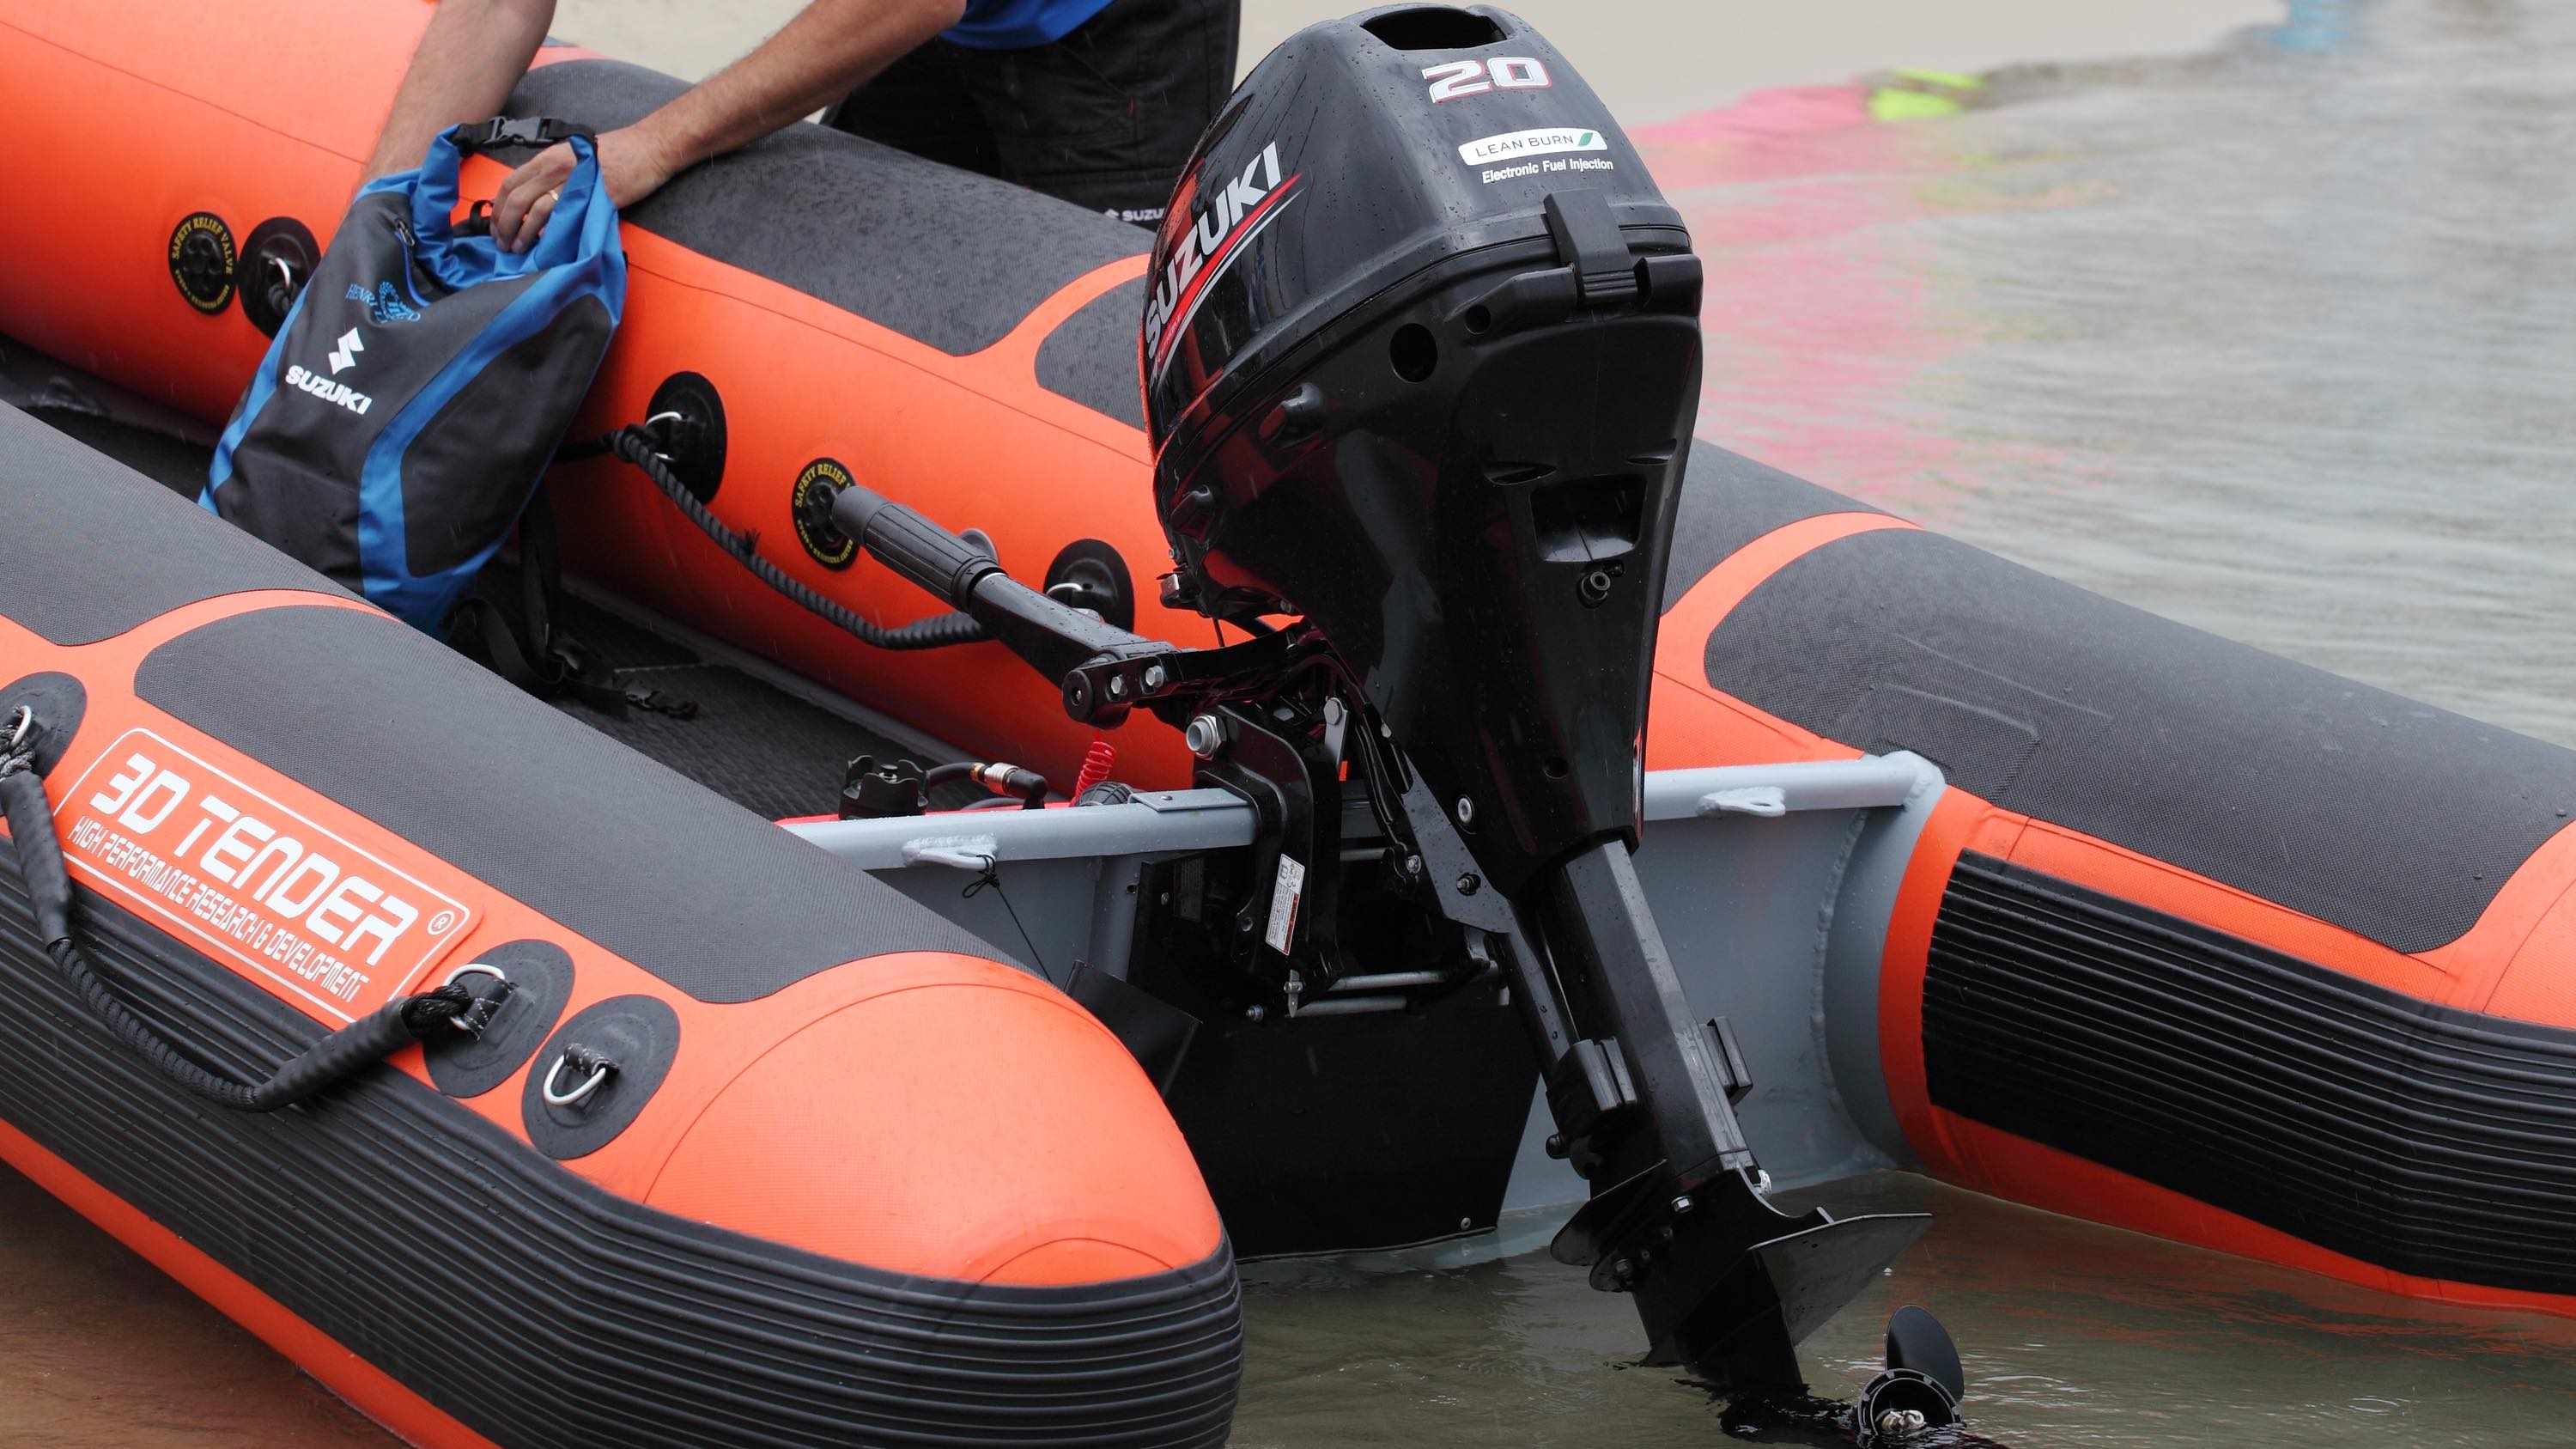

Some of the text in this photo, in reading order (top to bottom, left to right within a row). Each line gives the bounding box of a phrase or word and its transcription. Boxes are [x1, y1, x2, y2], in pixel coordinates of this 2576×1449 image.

[1421, 57, 1552, 104] 20
[1475, 135, 1574, 157] LEAN BURN
[1482, 158, 1613, 184] Electronic Fuel Injection
[1121, 208, 1165, 222] SUZU
[172, 216, 234, 275] SAFETY RELIEF VALVE
[1145, 141, 1282, 359] SUZUKI
[345, 283, 378, 307] HENRI
[285, 365, 372, 415] SUZUKI
[795, 464, 847, 508] SAFETY RELIEF
[89, 752, 419, 966] 3D TENDER
[68, 815, 369, 1003] HIGH PERFORMANCE RESEARCH & DEVELOPMENT
